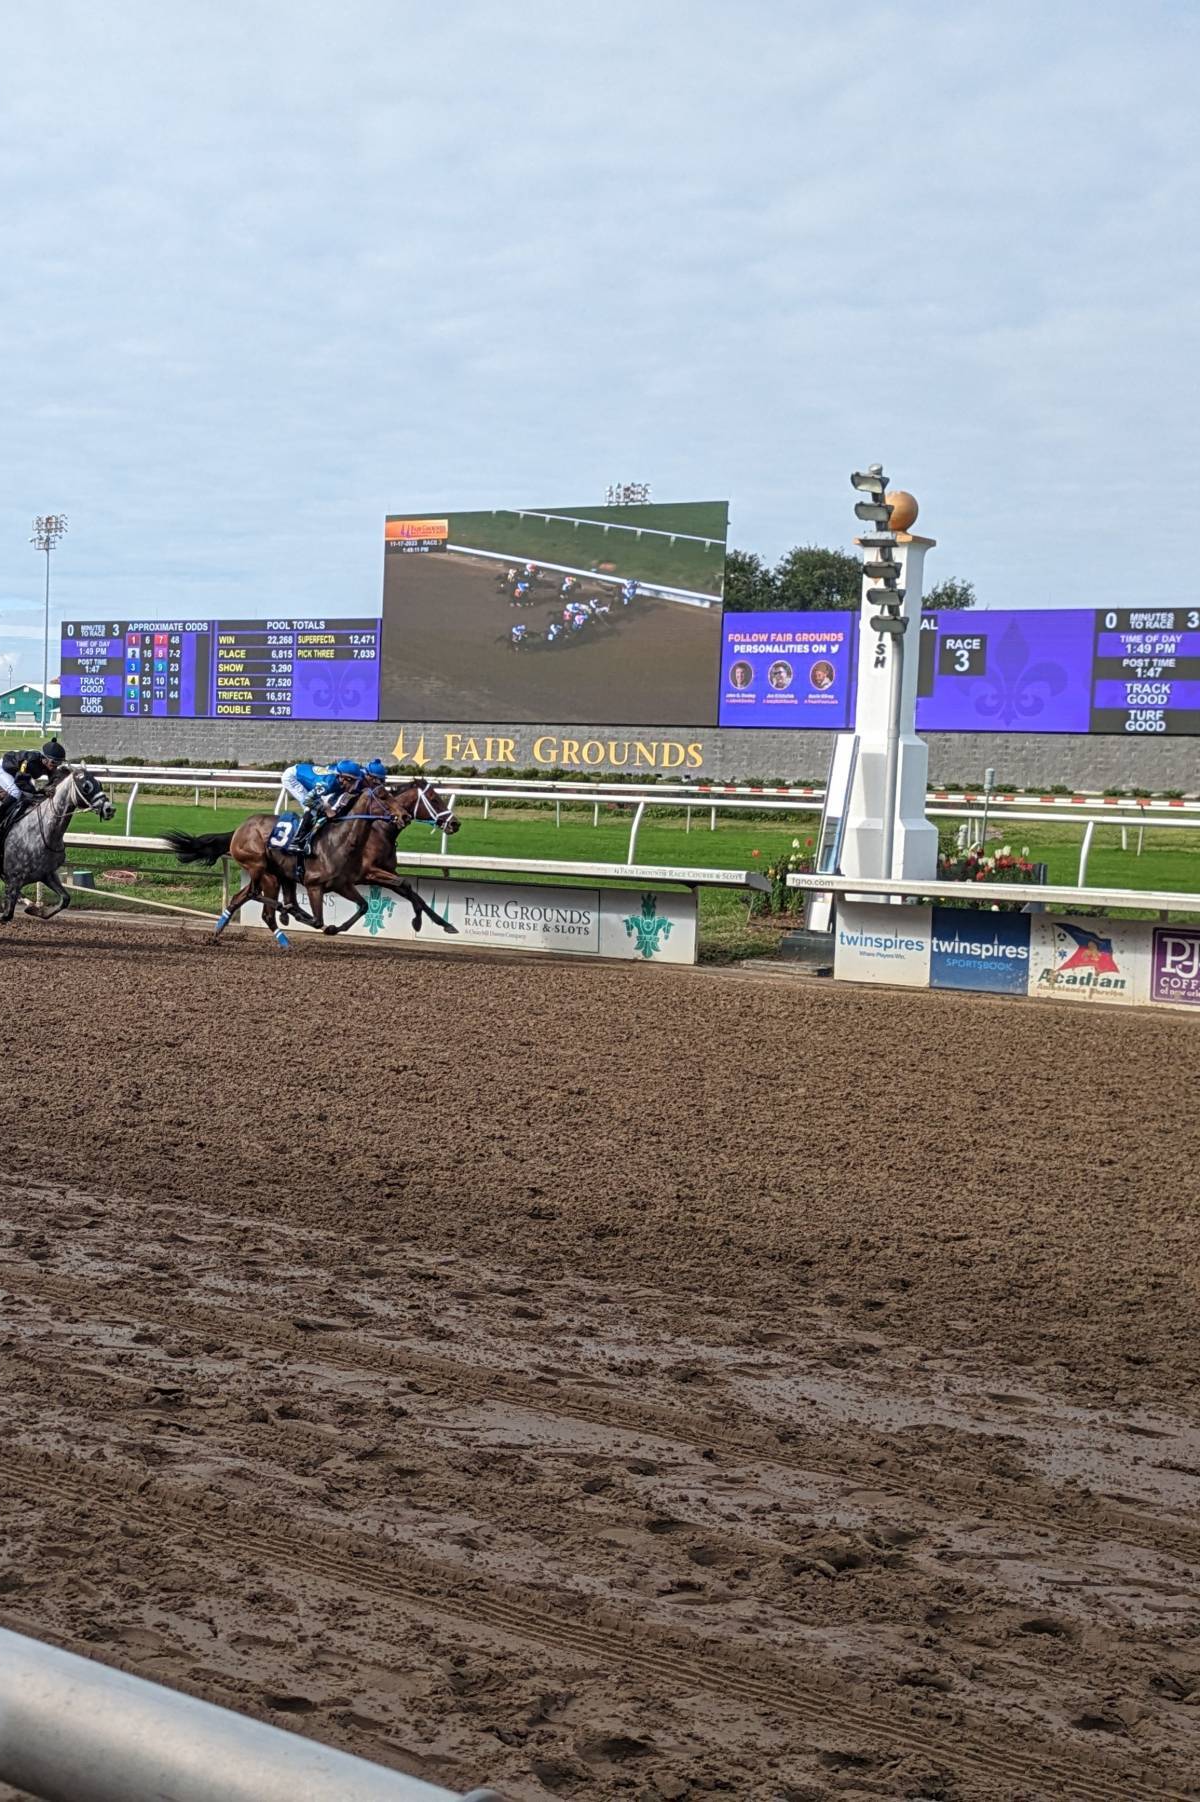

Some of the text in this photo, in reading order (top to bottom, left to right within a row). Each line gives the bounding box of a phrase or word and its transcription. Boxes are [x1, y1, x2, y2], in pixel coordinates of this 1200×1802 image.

[1105, 612, 1117, 629] 0
[1129, 612, 1174, 621] MINUTES
[1187, 611, 1200, 628] 3
[112, 624, 119, 636] 3
[127, 622, 209, 631] APPROXIMATE ODDS
[266, 621, 326, 630] POOL TOTALS
[1130, 621, 1174, 629] TO RACE
[67, 624, 74, 637] 0
[218, 635, 235, 644] WIN
[297, 635, 375, 645] SUPERFECTA 12,471
[728, 633, 844, 642] FOLLOW FAIR GROUNDS
[1120, 634, 1182, 643] TIME OF DAY
[733, 644, 827, 653] PERSONALITIES ON
[945, 638, 981, 650] RACE
[1125, 643, 1175, 654] 1:49 PM
[79, 647, 107, 655] 1:49 PM
[218, 649, 293, 659] PLACE 6,815
[297, 649, 376, 659] PICK THREE 7,039
[77, 658, 93, 666] POST
[954, 650, 970, 672] 3
[1122, 658, 1176, 667] POST TIME
[85, 665, 100, 673] 1:47
[144, 663, 150, 672] 2
[170, 663, 179, 672] 23
[218, 663, 292, 673] SHOW 3,290
[1135, 667, 1162, 678] 1:47
[79, 677, 105, 685] TRACK
[142, 677, 151, 685] 23
[156, 677, 165, 685] 10
[170, 677, 179, 685] 14
[217, 677, 292, 687] EXACTA 27,520
[80, 685, 103, 693] GOOD
[1125, 683, 1171, 694] TRACK
[82, 697, 102, 705] TURF
[217, 691, 292, 701] TRIFECTA 16,512
[1127, 694, 1168, 705] GOOD
[80, 705, 103, 713] GOOD
[144, 704, 149, 712] 3
[217, 705, 291, 715] DOUBLE 4,378
[1128, 710, 1164, 720] TURF
[1125, 721, 1166, 732] GOOD
[443, 733, 704, 768] FAIR GROUNDS
[270, 821, 293, 847] 3
[792, 877, 834, 887] fgno.com
[464, 896, 591, 925] FAIR GROUNDS
[464, 917, 590, 936] RACE COURSE & SLOTS
[839, 923, 925, 951] twinspires
[931, 931, 1029, 959] twinspires
[945, 957, 1014, 971] SPORTSBOOK
[1038, 968, 1126, 989] Acadian
[1160, 976, 1200, 990] COFF
[1160, 986, 1168, 995] of
